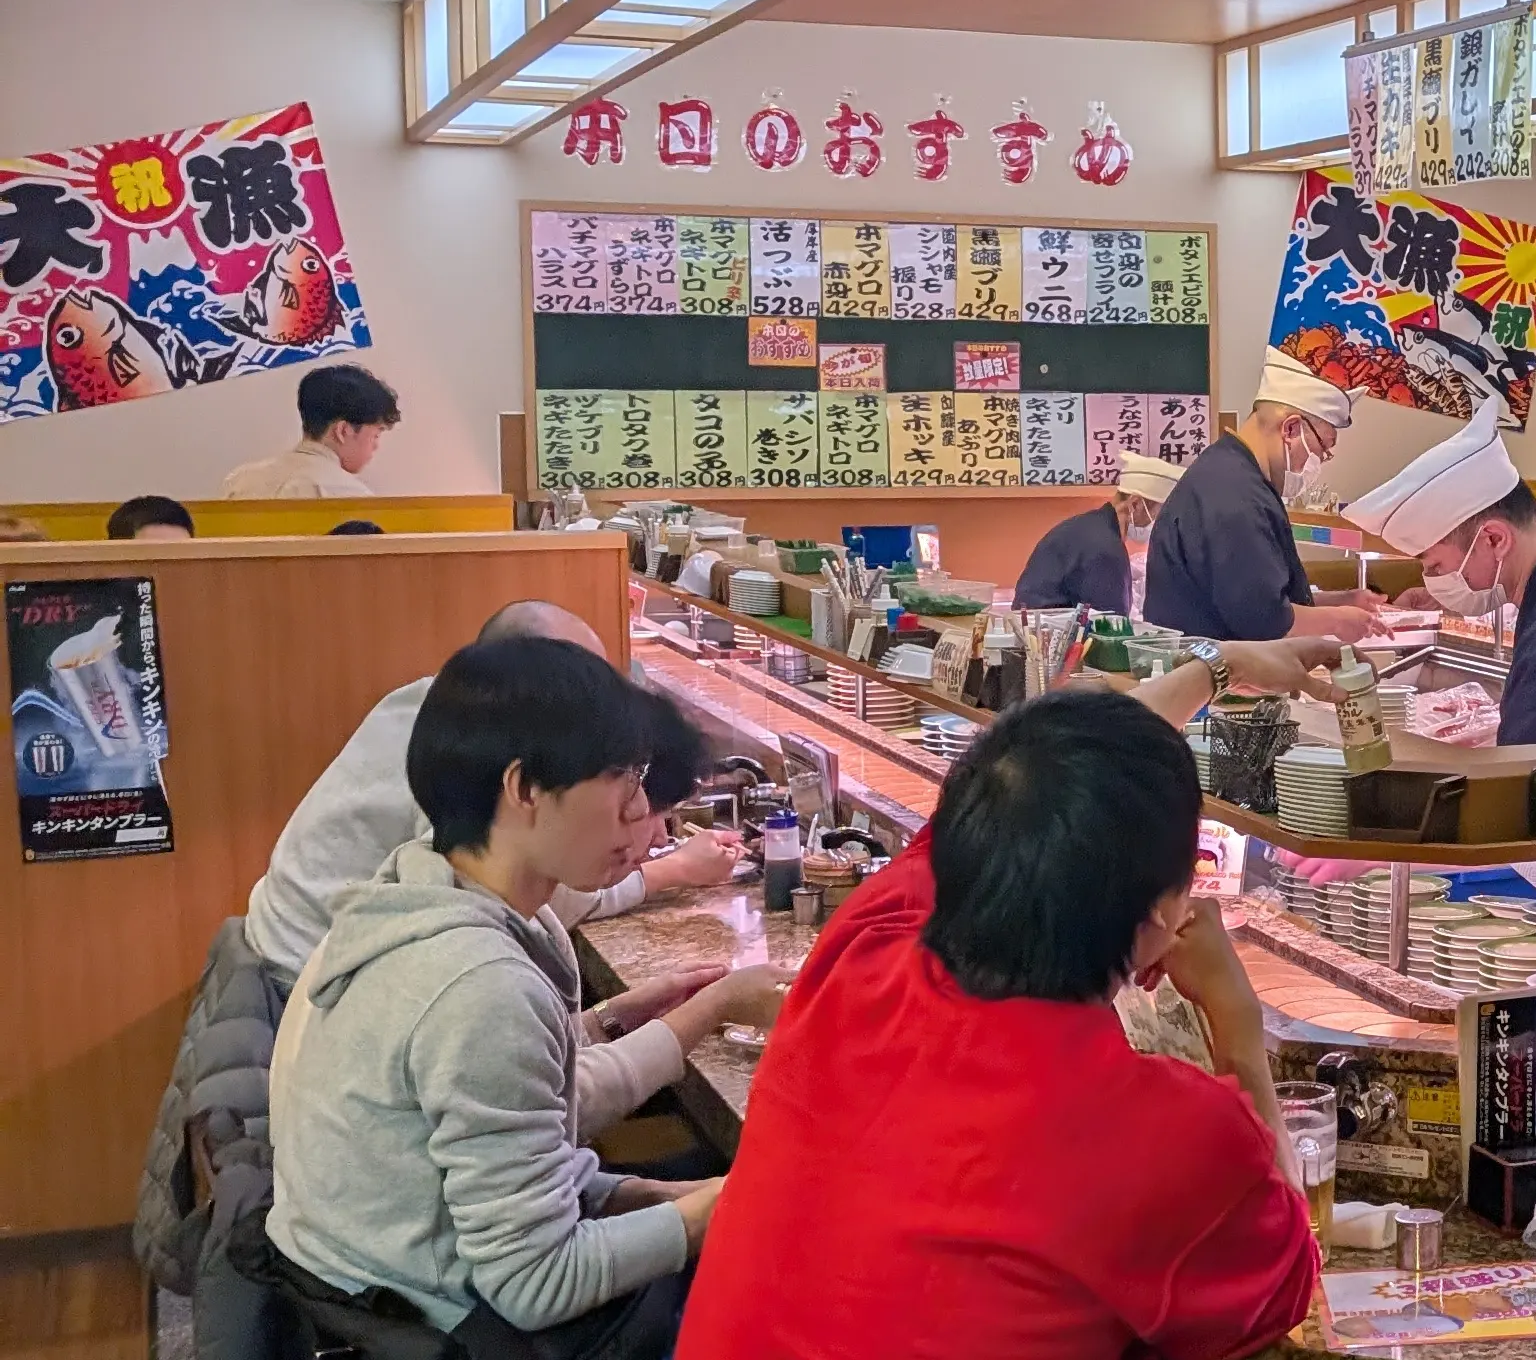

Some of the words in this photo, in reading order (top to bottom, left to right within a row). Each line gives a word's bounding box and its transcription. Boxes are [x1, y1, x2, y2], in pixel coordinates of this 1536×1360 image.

[563, 98, 1132, 187] 本日のおすすめ
[1349, 107, 1366, 169] ハラス
[1374, 164, 1407, 189] 429円
[1421, 159, 1455, 186] 429円
[1456, 152, 1492, 182] 242円
[1492, 149, 1529, 176] 308円
[110, 157, 172, 213] 祝
[568, 216, 598, 288] バチマグロ
[654, 218, 676, 283] 本マグロ
[680, 229, 707, 292] ネギトロ
[710, 218, 736, 280] 本マグロ
[760, 221, 792, 288] 活つぶ
[804, 222, 818, 262] 厚岸産
[855, 223, 883, 295] 本マグロ
[918, 228, 943, 293] シシャモ
[1118, 233, 1144, 288] 白身の
[1307, 186, 1460, 295] 大漁
[537, 248, 567, 288] ハラス
[608, 240, 629, 293] うずら
[630, 228, 652, 298] ネギトロ
[823, 262, 852, 299] 赤身
[1038, 230, 1073, 302] 鮮ウニ
[1180, 236, 1202, 306] ボタンエビの
[536, 294, 605, 311] 374円
[892, 266, 916, 301] 握り
[609, 296, 677, 312] 374円
[681, 296, 747, 314] 308円
[753, 296, 820, 315] 528円
[826, 300, 888, 316] 429円
[894, 303, 955, 319] 528円
[958, 303, 1018, 320] 429円
[1025, 302, 1086, 321] 968円
[1089, 307, 1147, 322] 242円
[1150, 307, 1207, 323] 308円
[762, 324, 800, 338] 本日の
[1493, 302, 1532, 349] 祝
[751, 337, 812, 359] おすすめ
[825, 378, 881, 388] 本日入荷
[621, 394, 653, 468] トロタク巻
[783, 394, 814, 464] サバシソ
[855, 394, 880, 452] 本マグロ
[901, 394, 935, 464] 生ホッキ
[982, 396, 1005, 459] 本マグロ
[1053, 397, 1079, 425] ブリ
[1159, 397, 1189, 464] あん肝
[543, 395, 573, 470] ネギたたき
[691, 394, 727, 470] タコの子
[752, 428, 783, 465] 巻き
[826, 404, 852, 465] ネギトロ
[957, 419, 980, 467] あぶり
[1025, 397, 1052, 468] ネギたたき
[1093, 429, 1115, 466] ロール
[606, 471, 673, 488] 308円
[679, 471, 745, 488] 308円
[750, 468, 818, 487] 308円
[822, 469, 886, 485] 308円
[893, 469, 955, 486] 429円
[957, 470, 1018, 485] 429円
[1024, 469, 1085, 484] 242円
[32, 813, 162, 834] キンキンタンブラー
[1495, 1010, 1510, 1139] キンキンタンブラー
